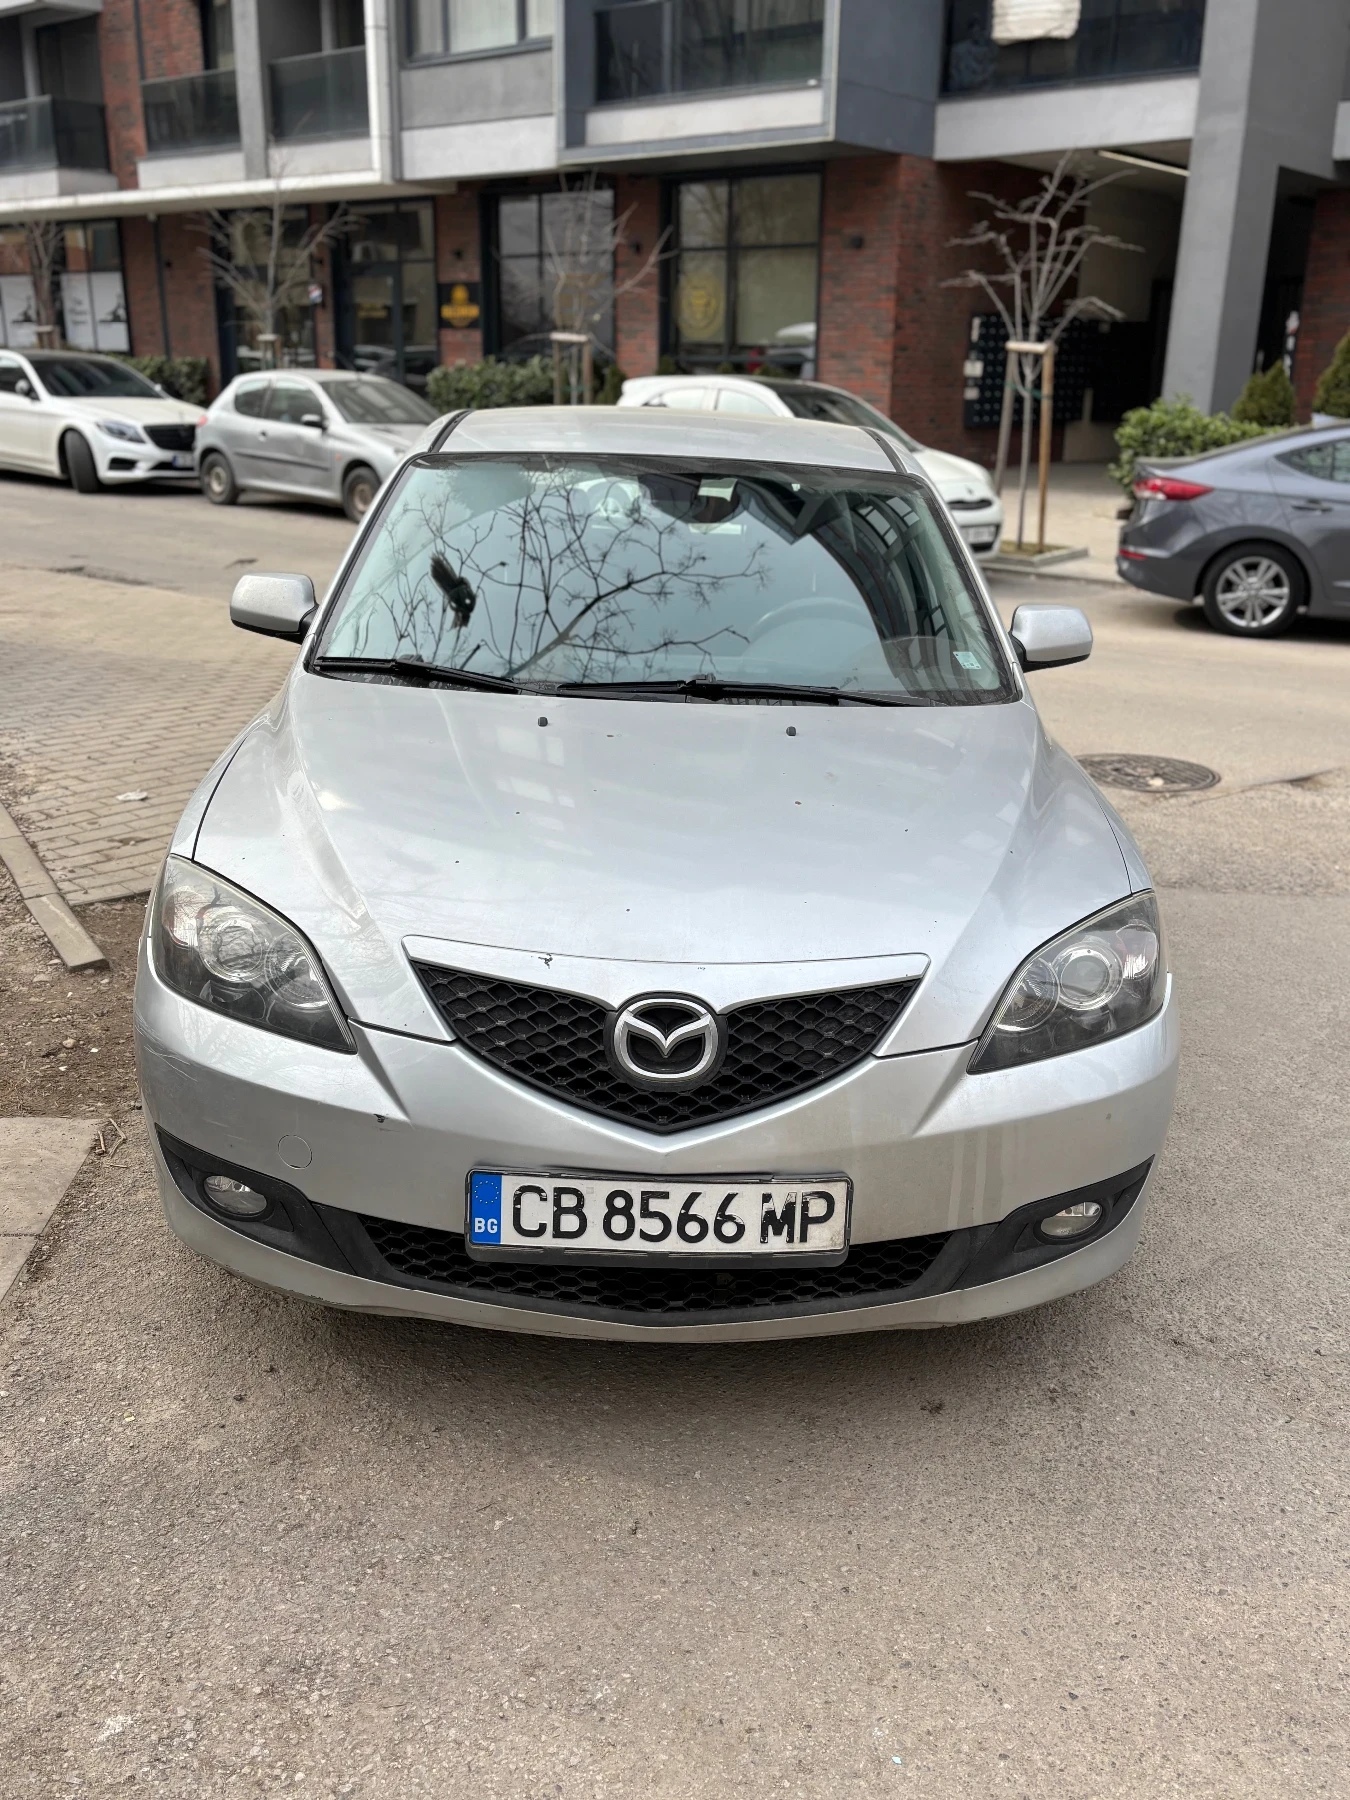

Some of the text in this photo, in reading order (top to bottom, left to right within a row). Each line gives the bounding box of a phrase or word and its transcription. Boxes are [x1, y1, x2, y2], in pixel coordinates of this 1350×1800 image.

[474, 1217, 498, 1234] BG
[512, 1184, 836, 1244] CB 8566 MP
